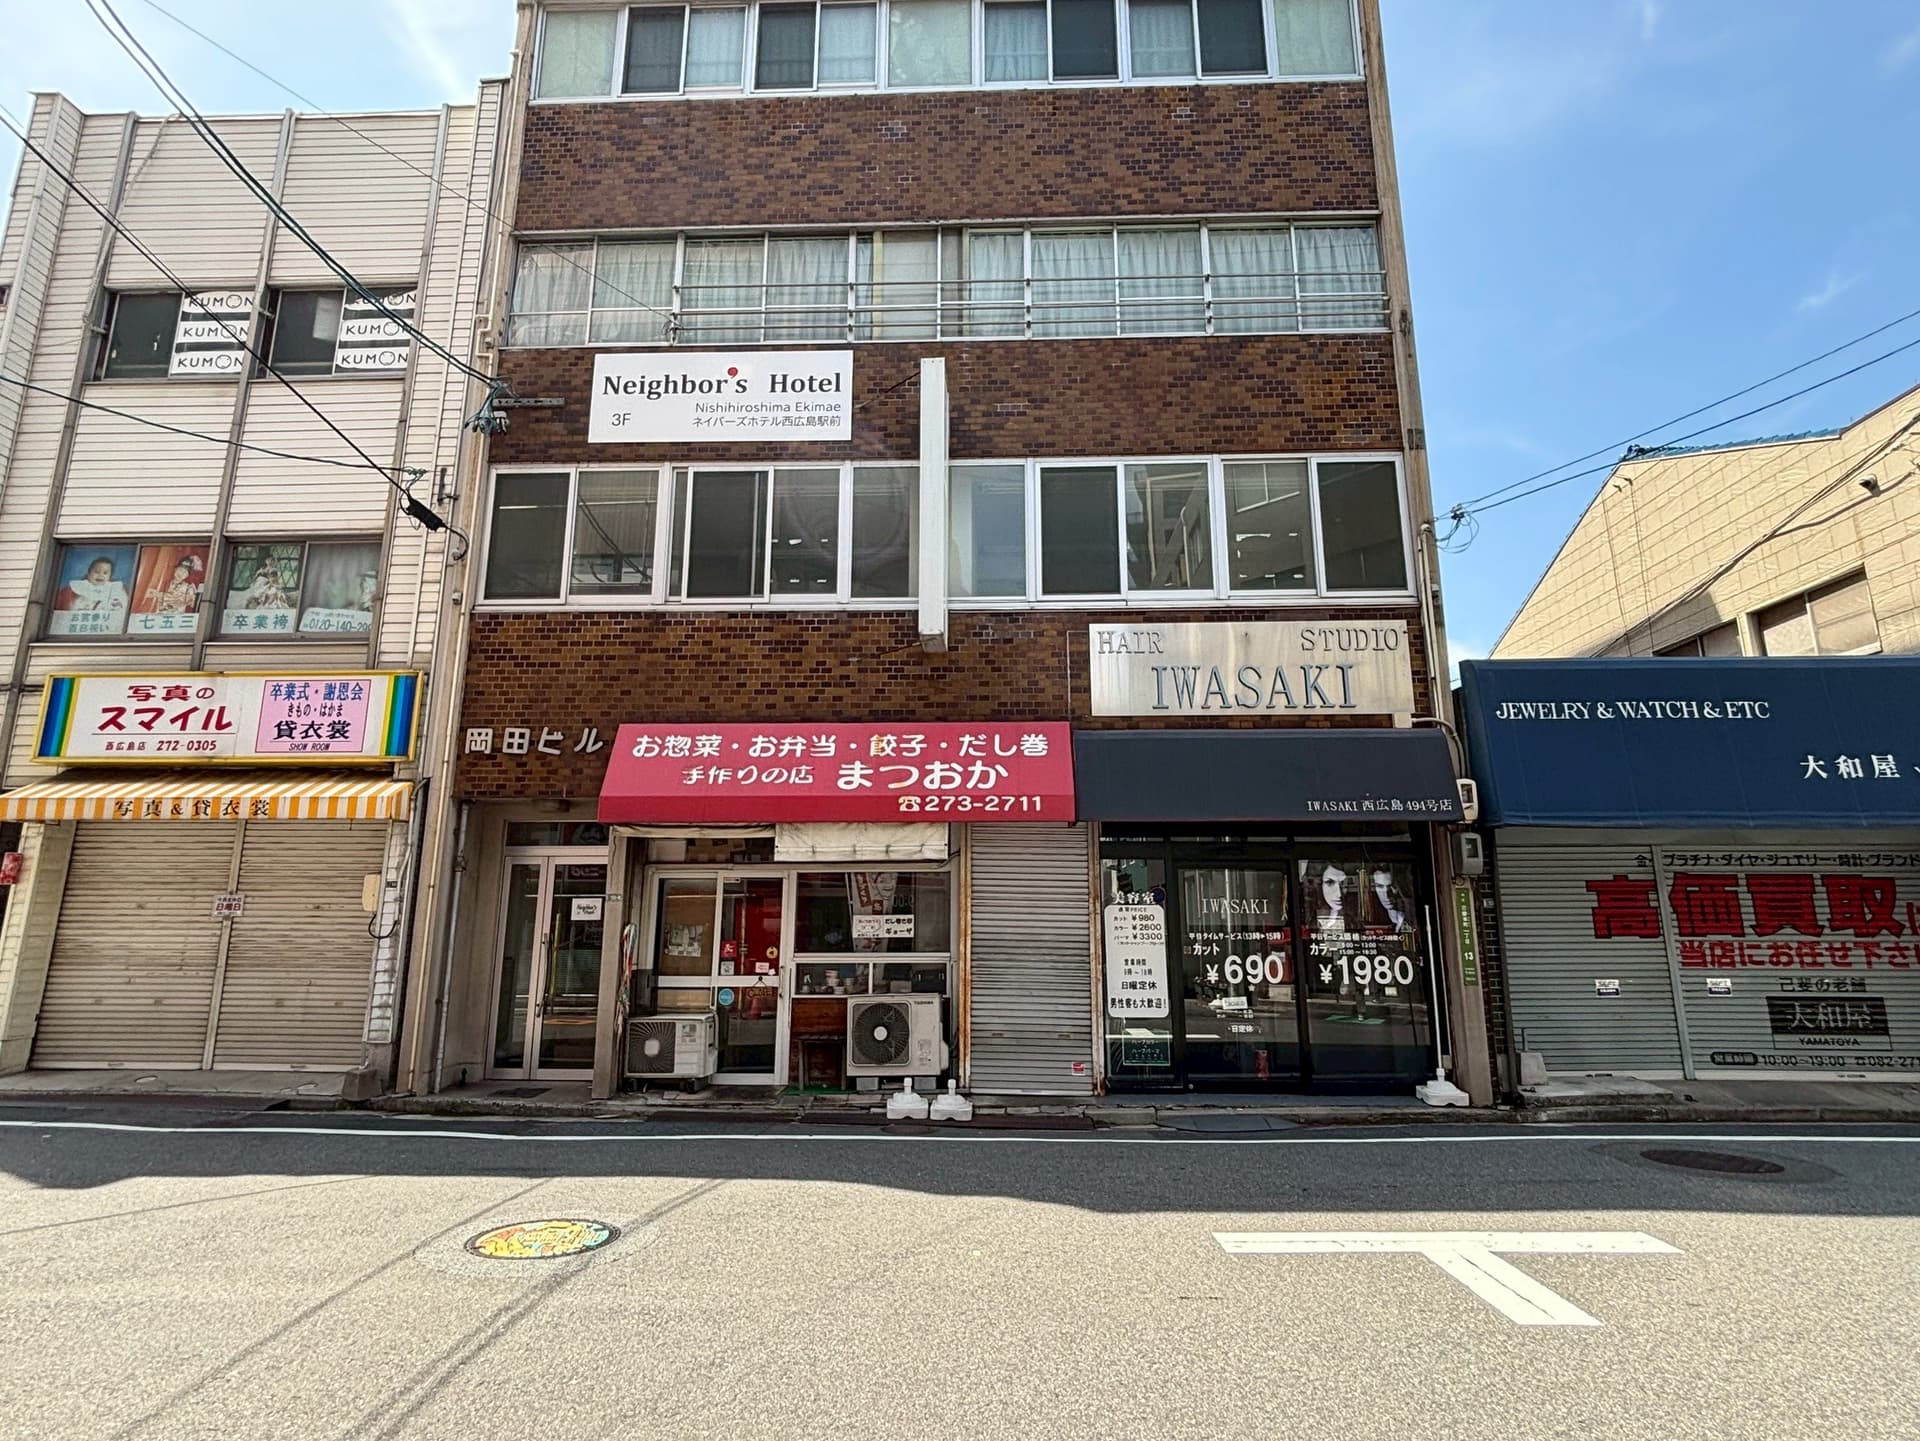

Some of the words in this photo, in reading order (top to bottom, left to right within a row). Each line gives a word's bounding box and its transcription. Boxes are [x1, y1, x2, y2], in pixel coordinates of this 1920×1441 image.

[183, 324, 249, 339] KUMON
[177, 354, 243, 370] KUMON
[341, 351, 408, 366] KUMON
[603, 367, 748, 400] Neighbor's
[769, 374, 842, 393] Hotel
[695, 402, 791, 413] Nishihiroshima
[795, 402, 841, 413] Ekimae
[611, 413, 632, 427] 3F
[692, 415, 842, 428] ネイバーズホテル西広島駅前
[139, 615, 194, 630] 七五三
[233, 614, 289, 630] 卒業袴
[1098, 630, 1165, 654] HAIR
[1300, 627, 1399, 652] STUDIO
[127, 685, 215, 702] 写真の
[270, 682, 364, 701] 卒業式・謝恩会
[1151, 664, 1358, 710] IWASAKI
[97, 706, 233, 731] スマイル
[1496, 702, 1591, 720] JEWELRY
[1616, 701, 1700, 720] WATCH
[1727, 701, 1770, 719] ETC
[273, 720, 351, 740] 貸衣裳
[105, 741, 147, 751] 西広島店
[156, 740, 217, 751] 272-0305
[288, 743, 308, 751] SHOW
[311, 743, 331, 751] ROOM
[465, 726, 603, 756] 岡田ビル
[682, 766, 815, 785] 手作りの店
[837, 760, 1009, 790] まつおか
[1799, 754, 1901, 780] 大和屋
[924, 795, 1042, 812] 273-2711
[1307, 801, 1358, 811] IWASAKI
[1201, 899, 1269, 914] IWASAKI
[1193, 942, 1220, 956] カット
[1310, 942, 1338, 956] カラー
[1464, 952, 1474, 960] 13
[1206, 955, 1283, 985] ¥690
[1319, 955, 1414, 985] ¥1980
[1121, 981, 1158, 991] 日曜定休
[1785, 1001, 1874, 1030] 大和屋
[1799, 1038, 1861, 1047] YAMATOYA
